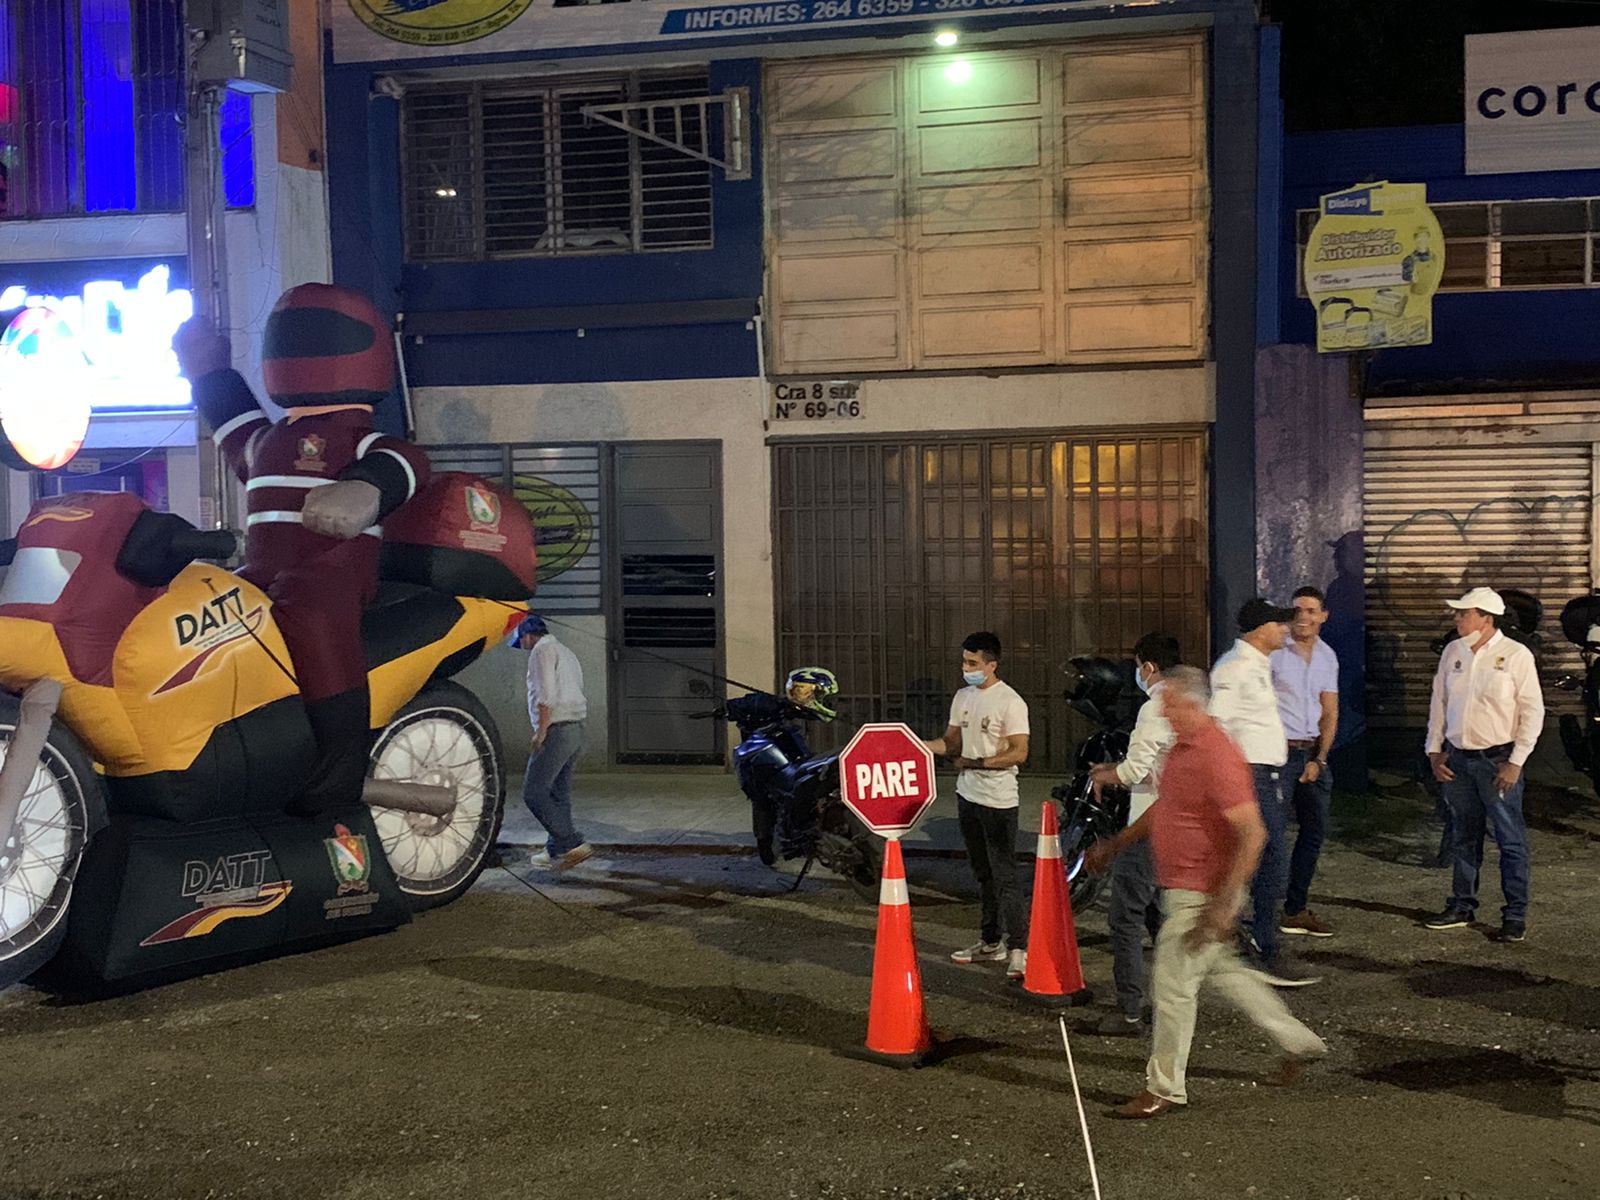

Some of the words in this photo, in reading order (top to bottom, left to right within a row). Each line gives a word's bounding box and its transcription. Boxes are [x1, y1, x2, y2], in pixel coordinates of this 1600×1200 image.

[684, 4, 807, 30] INFORMES:
[812, 1, 851, 19] 264
[857, 0, 913, 16] 6359
[1315, 242, 1403, 262] Autorizado
[775, 384, 806, 400] Cra
[812, 383, 824, 400] 8
[175, 586, 244, 646] DATT
[856, 760, 919, 800] PARE
[181, 849, 272, 897] DATT
